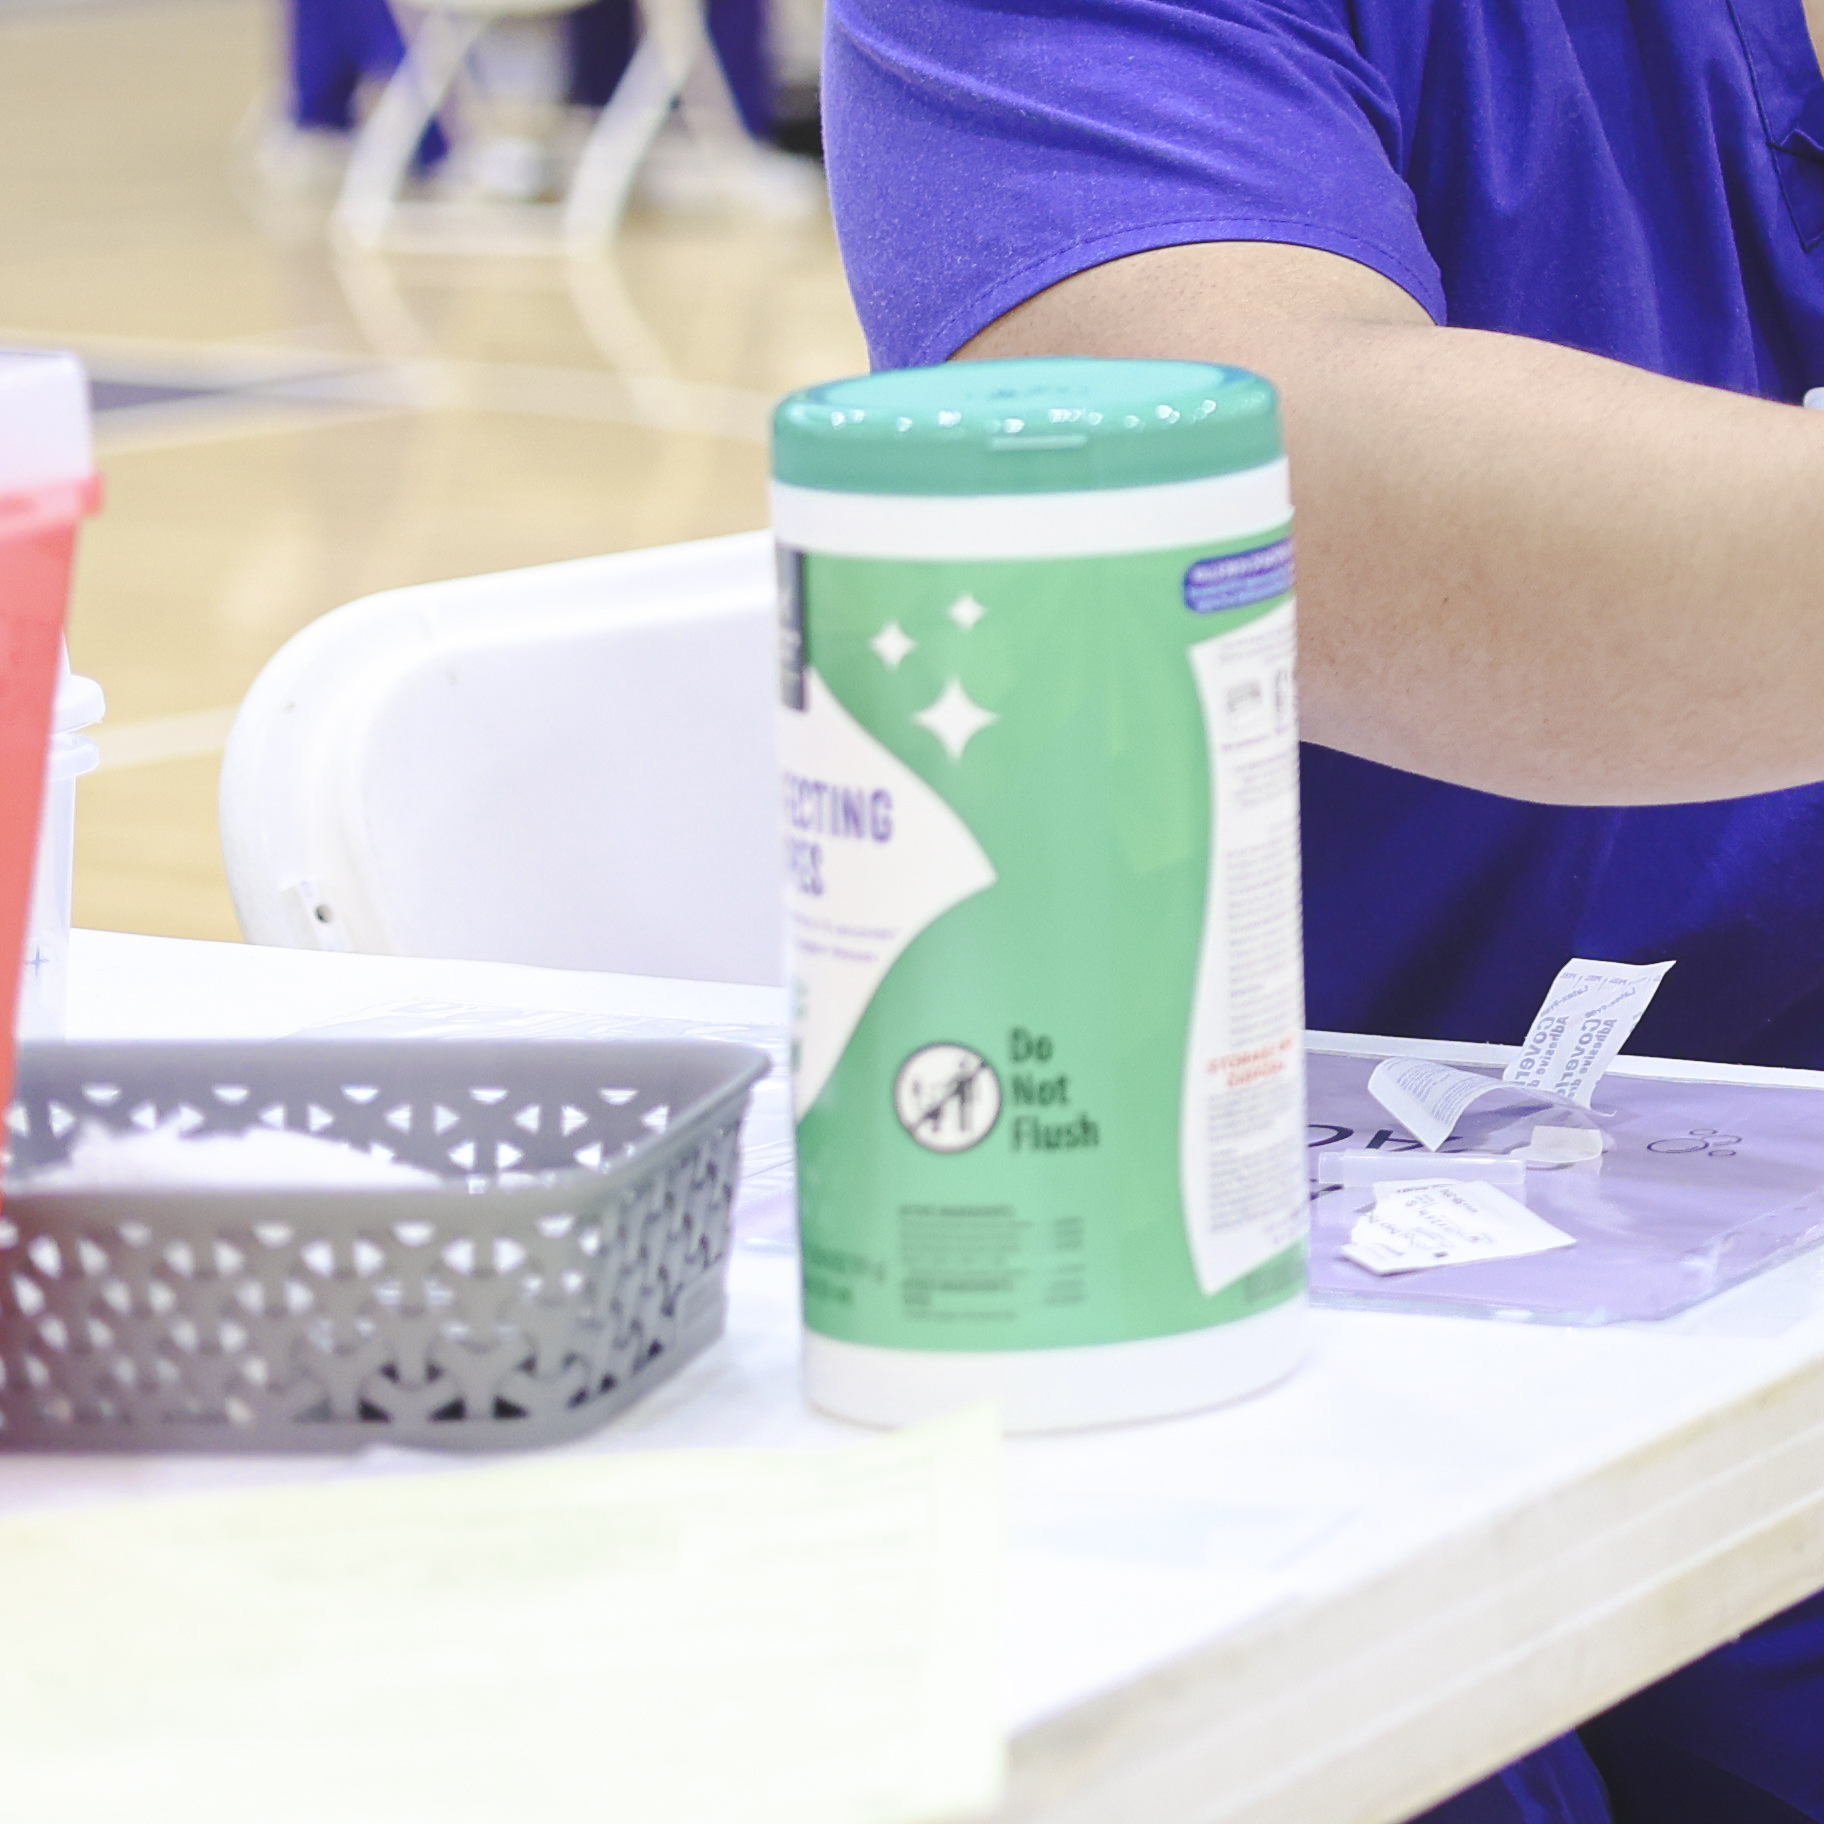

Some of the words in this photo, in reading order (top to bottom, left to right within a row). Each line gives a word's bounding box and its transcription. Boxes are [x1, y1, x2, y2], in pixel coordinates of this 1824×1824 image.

[1010, 1027, 1053, 1064] Do
[1012, 1074, 1071, 1108] Not
[1011, 1112, 1102, 1153] Flush
